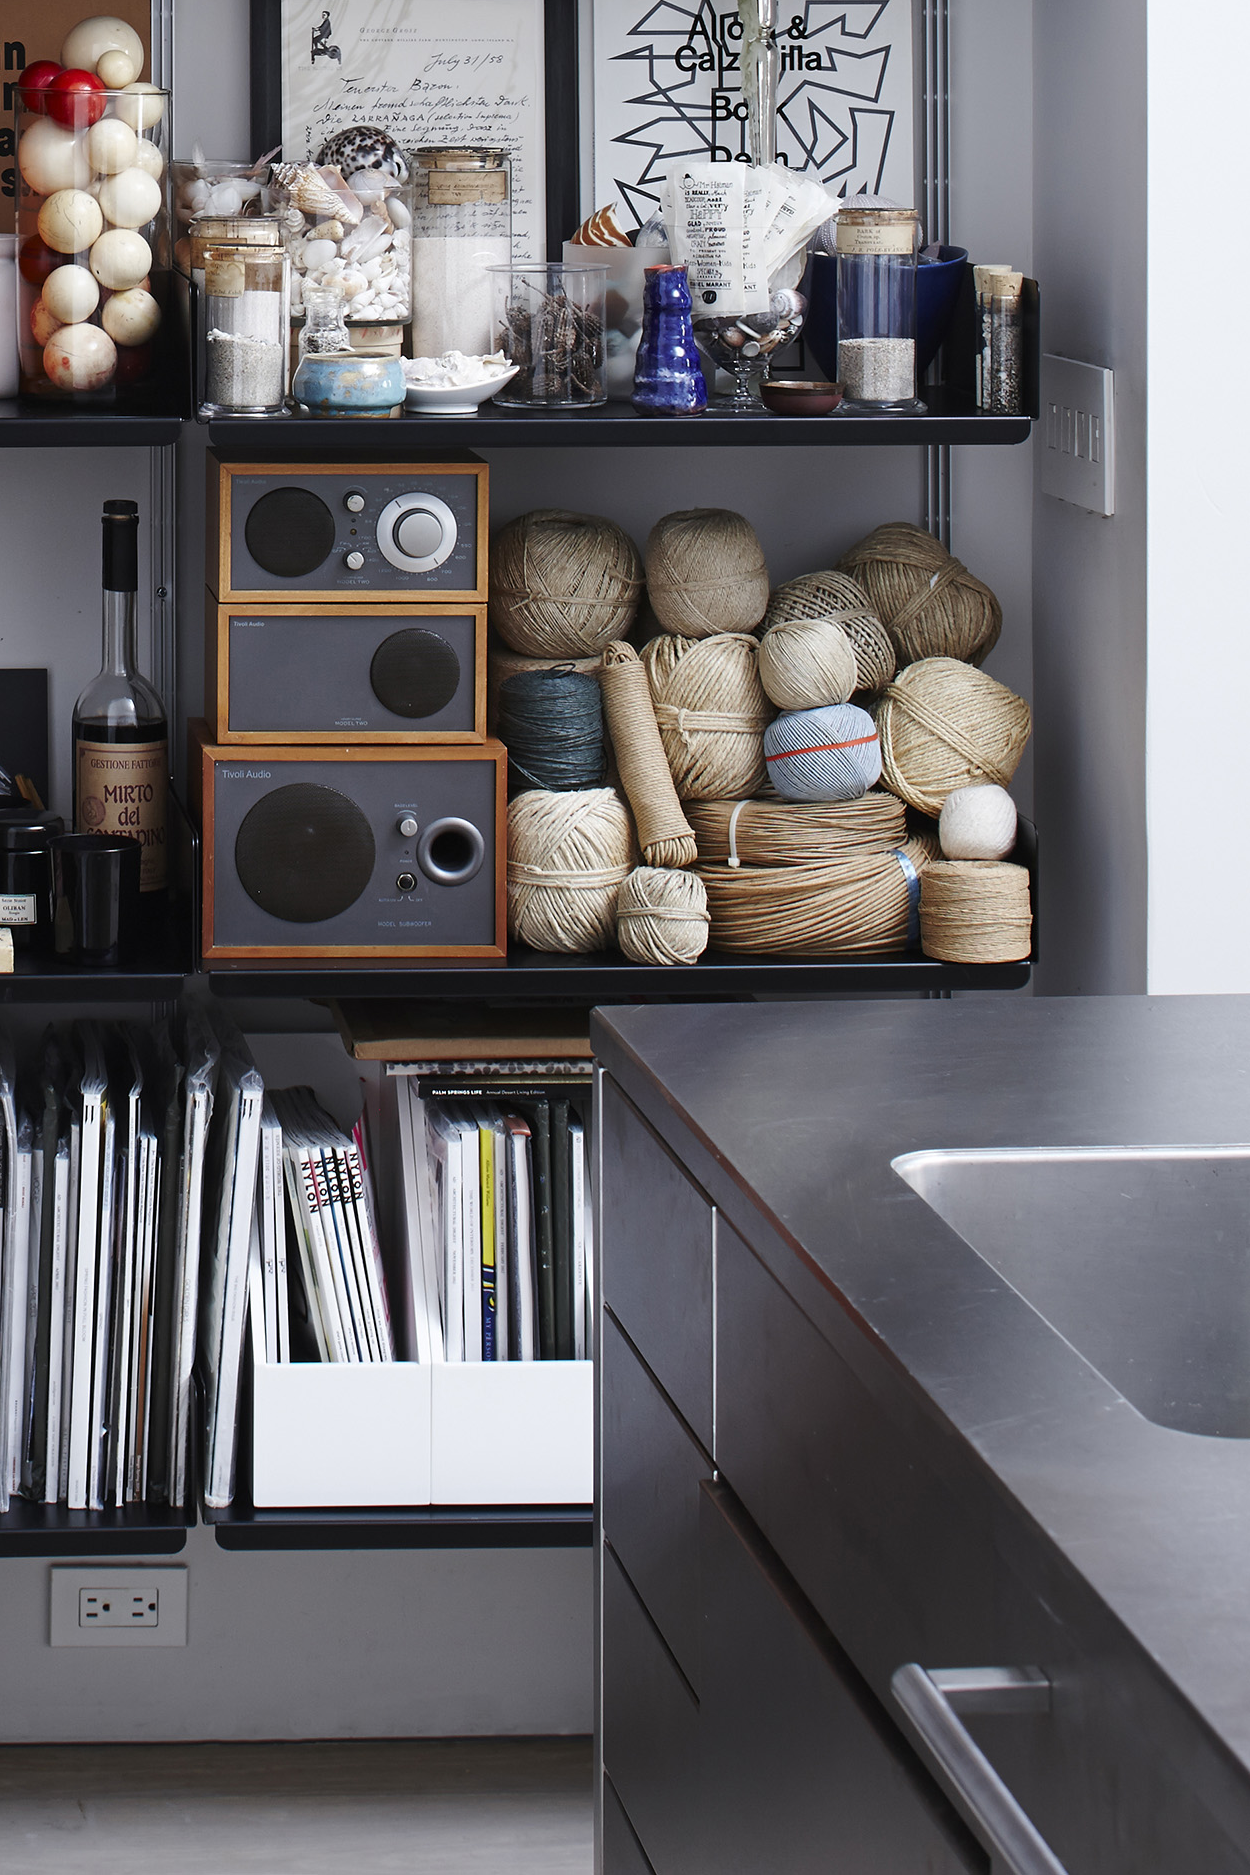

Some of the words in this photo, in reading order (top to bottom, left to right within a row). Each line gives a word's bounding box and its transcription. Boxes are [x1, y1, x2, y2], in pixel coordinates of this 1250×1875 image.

[90, 758, 130, 770] GESTIONE
[222, 769, 245, 779] Tivoli
[245, 770, 272, 779] Audio
[103, 784, 154, 804] MIRTO
[118, 806, 141, 827] del
[300, 1161, 319, 1214] NYLON
[313, 1160, 331, 1207] NYLON
[325, 1156, 342, 1203] NYLON
[336, 1157, 353, 1205] NYLON
[349, 1152, 365, 1200] NYLON
